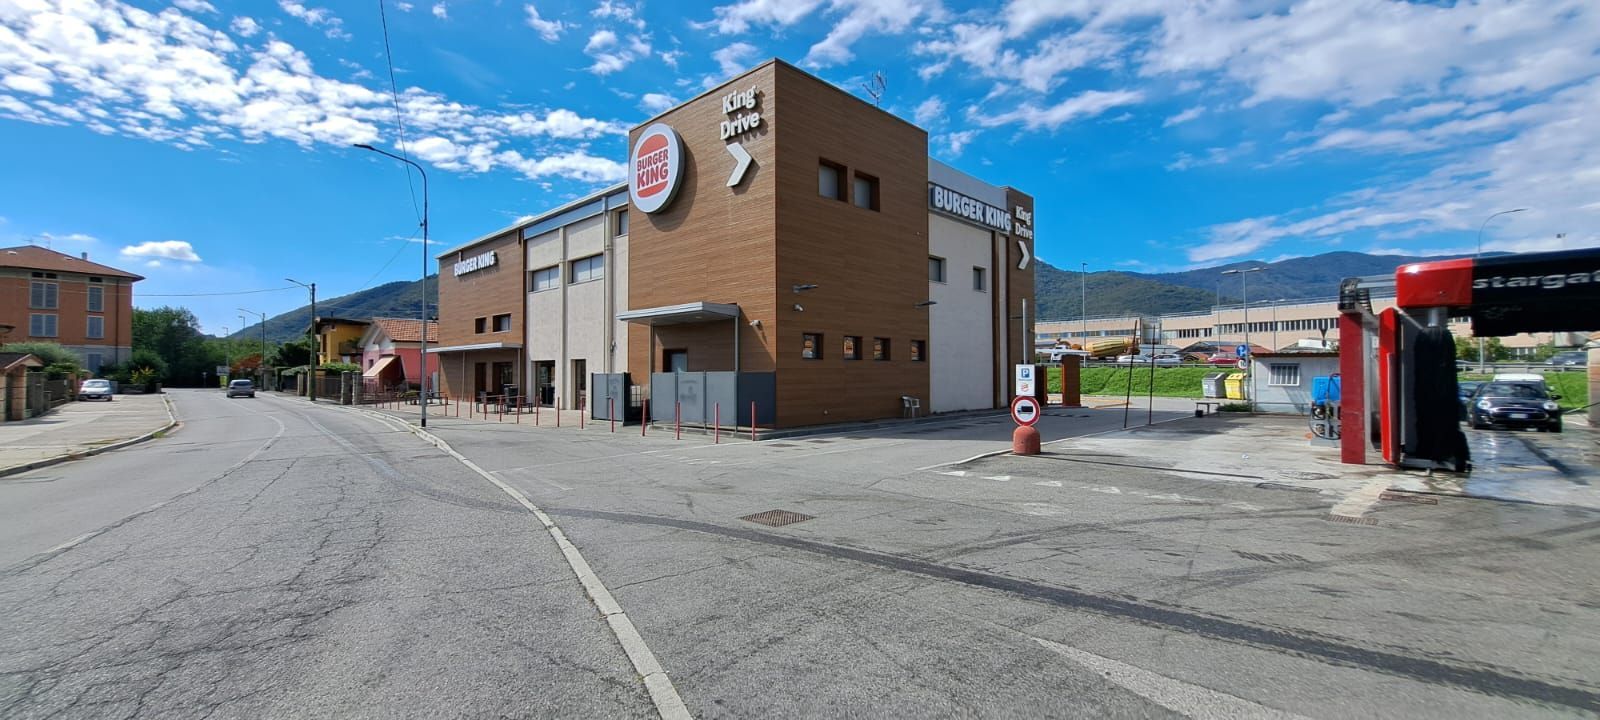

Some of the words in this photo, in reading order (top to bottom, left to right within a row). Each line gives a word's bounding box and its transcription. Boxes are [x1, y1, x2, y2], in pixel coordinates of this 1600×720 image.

[722, 85, 758, 114] King
[720, 112, 760, 140] Drive
[636, 149, 669, 172] BURGER
[636, 161, 669, 189] KING
[934, 186, 984, 222] BURGER
[985, 205, 1011, 231] KING
[1015, 205, 1032, 225] King
[1015, 222, 1033, 240] Drive
[454, 256, 478, 277] BURGER
[477, 250, 496, 269] KING
